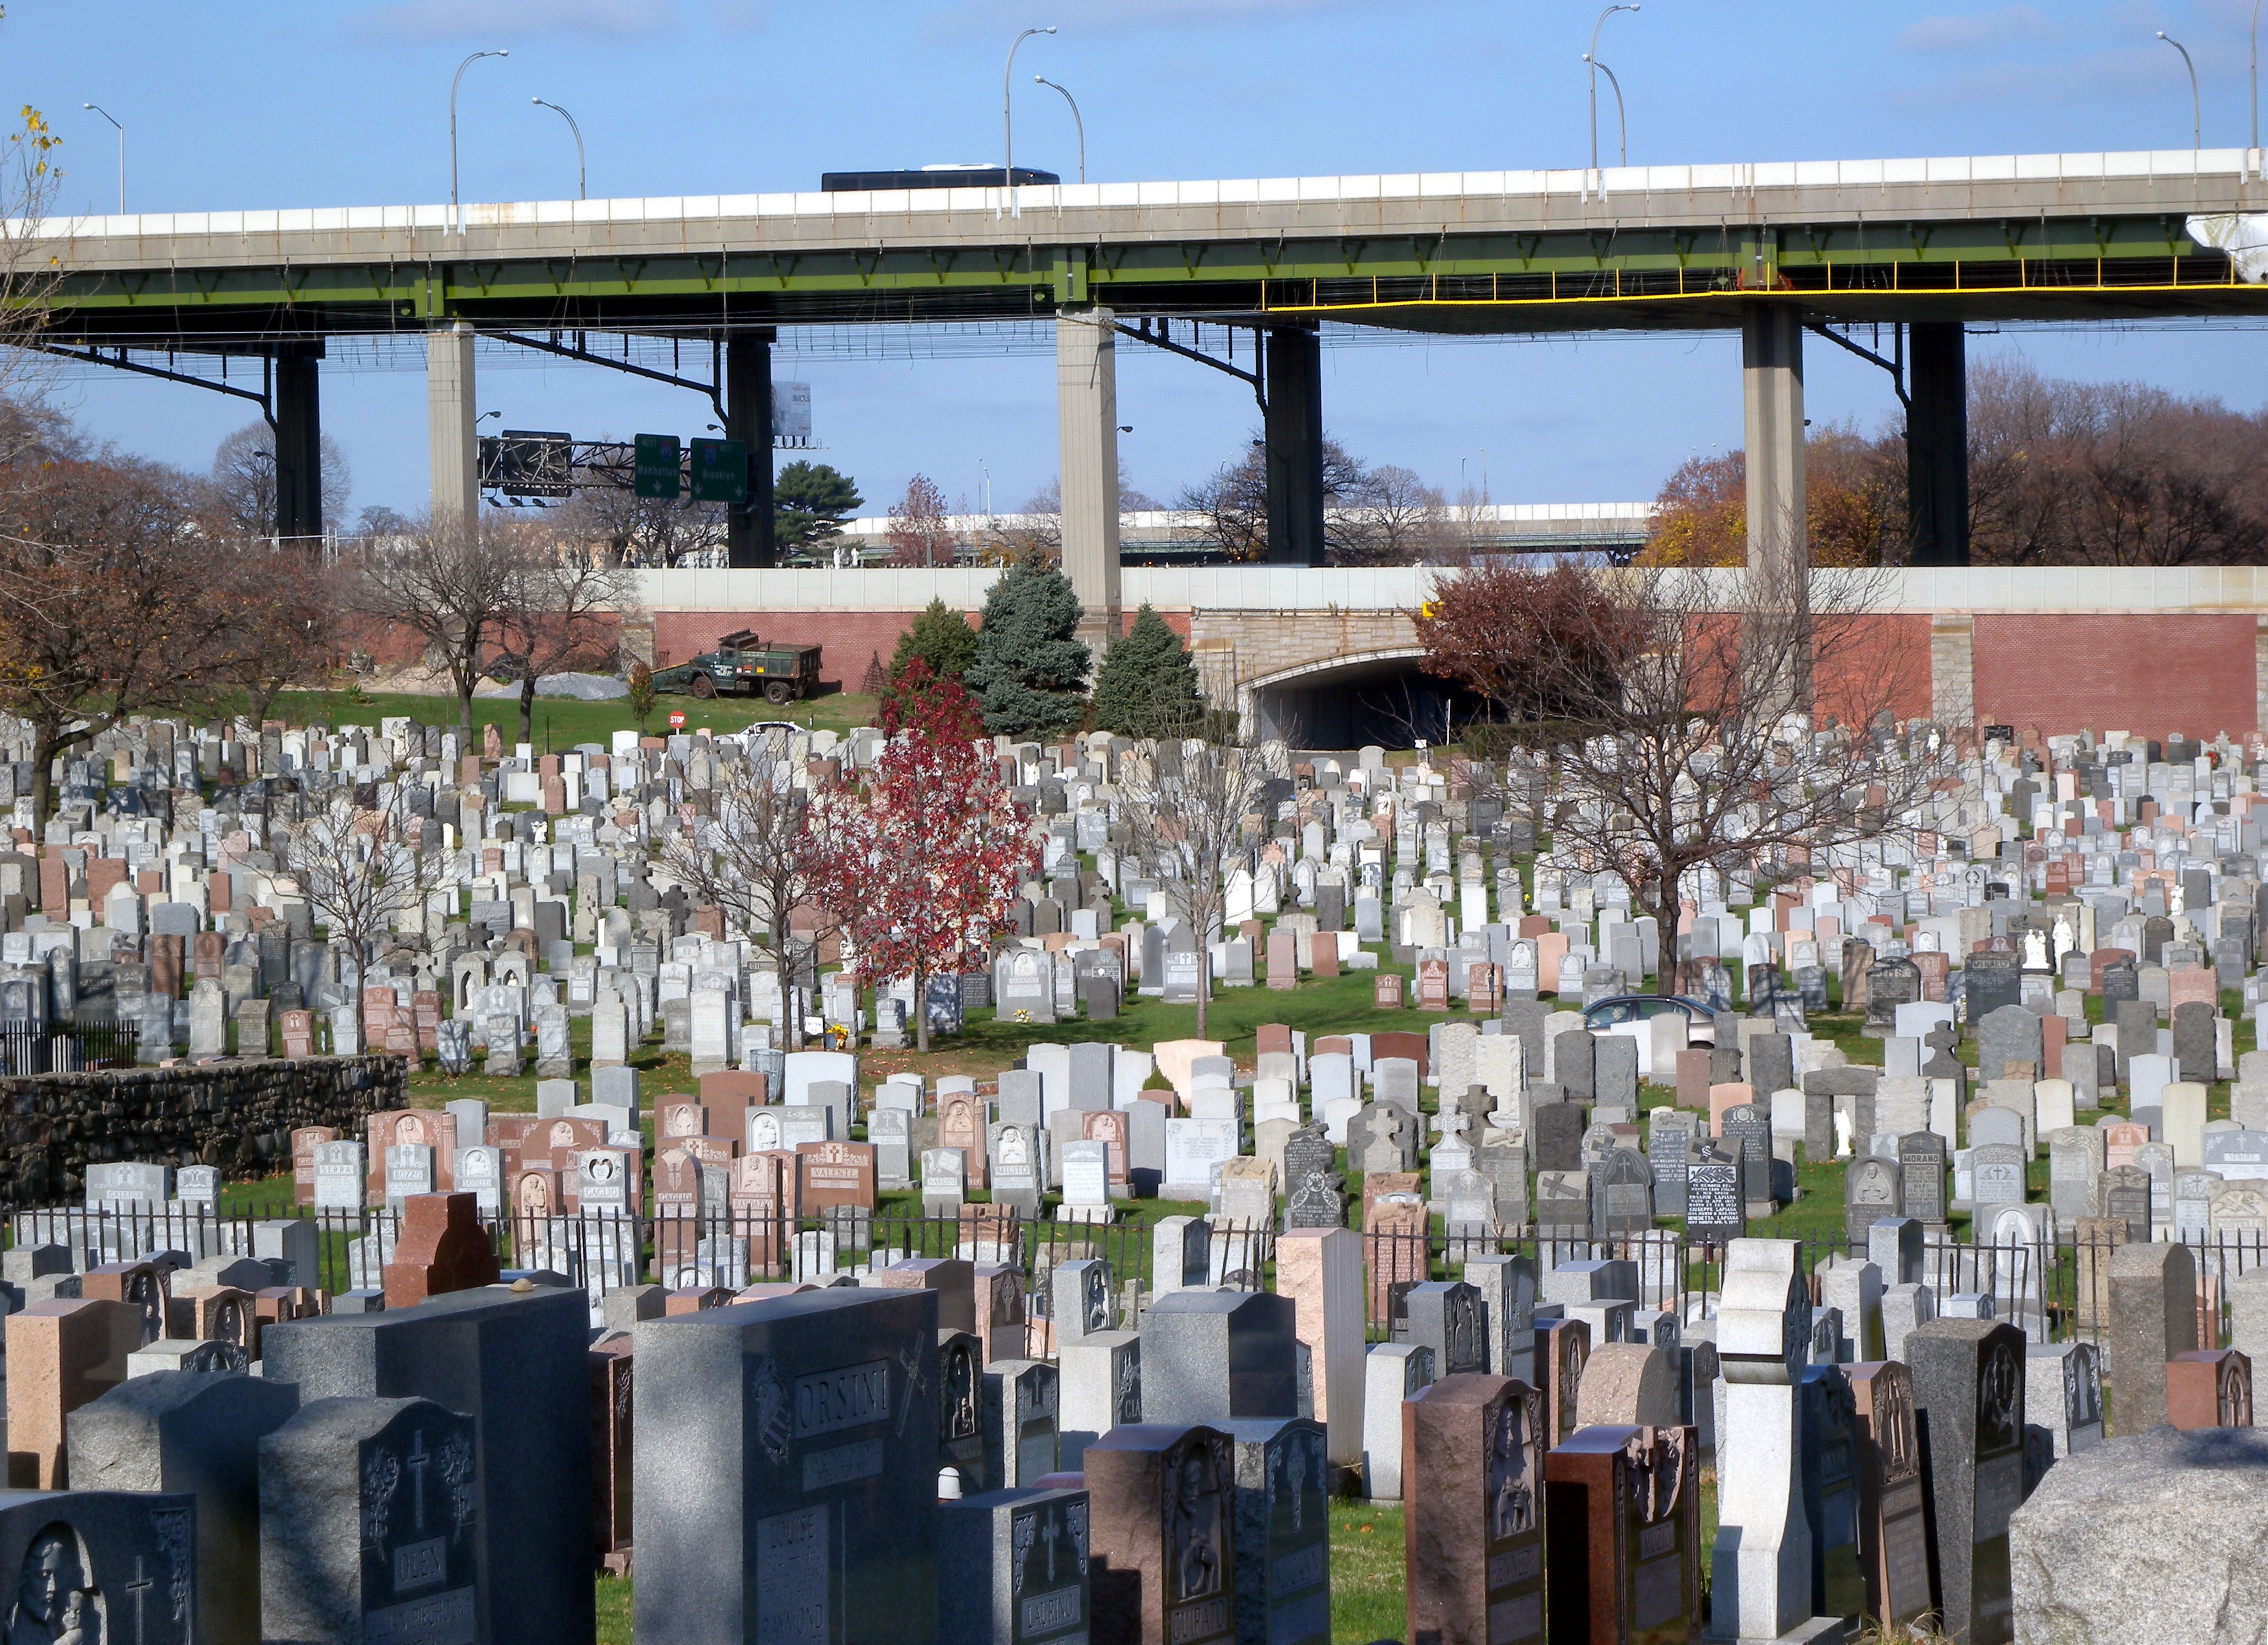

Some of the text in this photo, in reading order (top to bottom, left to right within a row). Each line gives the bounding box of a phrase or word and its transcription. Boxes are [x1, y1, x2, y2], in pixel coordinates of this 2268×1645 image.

[638, 465, 678, 477] Manhattan
[702, 468, 736, 481] Brooklyn
[670, 716, 685, 724] STOP
[322, 1165, 352, 1173] SERRA
[395, 1170, 422, 1179] BOZZO
[814, 1168, 855, 1178] VALENTE
[996, 1165, 1028, 1174] MILITO
[928, 1178, 957, 1186] NARDINI
[586, 1188, 618, 1197] GAGLIO
[801, 1368, 887, 1428] ORSINI
[400, 1545, 442, 1582] OLEN
[1490, 1549, 1537, 1586] KENNEDY
[1028, 1594, 1074, 1629] LAURINO
[1173, 1600, 1227, 1640] GUIRATO
